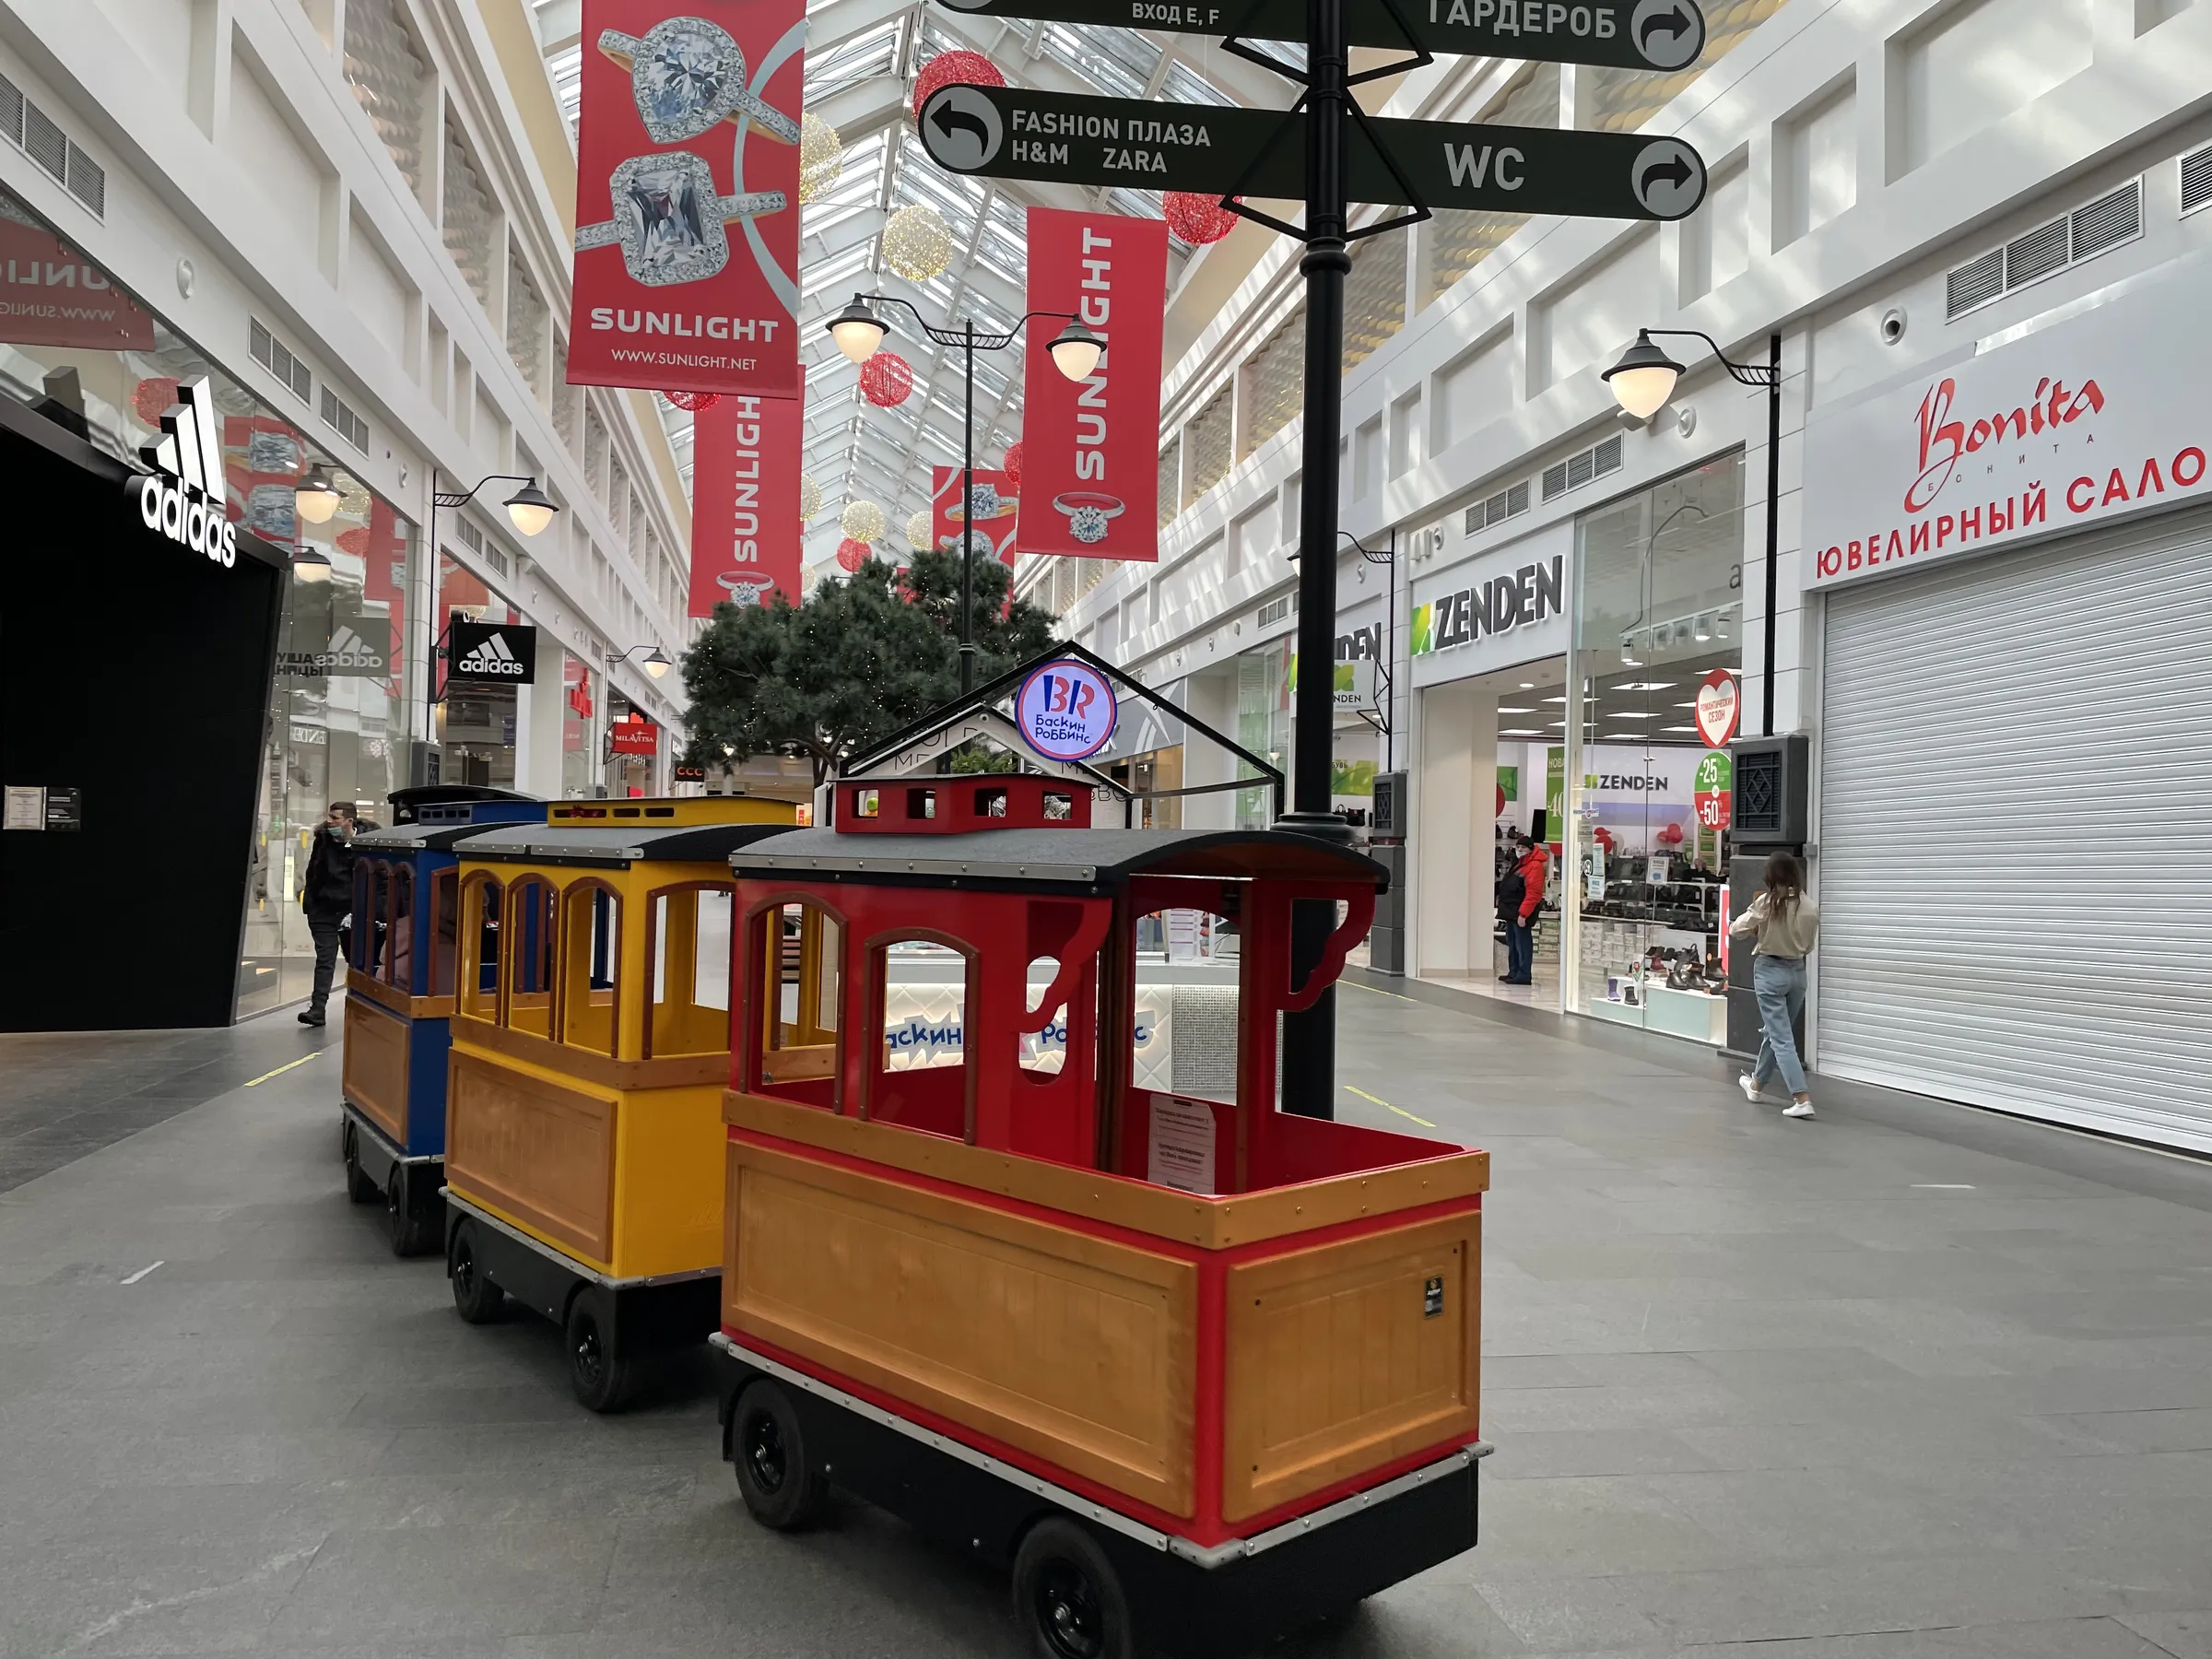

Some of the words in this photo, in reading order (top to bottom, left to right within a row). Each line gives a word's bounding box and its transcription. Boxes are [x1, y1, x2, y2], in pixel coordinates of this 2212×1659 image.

[1132, 3, 1182, 25] ВХОД
[1209, 9, 1220, 25] F
[1012, 109, 1119, 139] FASHION
[1128, 120, 1211, 147] ПЛАЗА
[1012, 139, 1068, 164] H&M
[1102, 147, 1168, 173] ZARA
[1443, 143, 1525, 191] WC
[590, 308, 779, 342] SUNLIGHT
[611, 348, 758, 371] WWW.SUNLIGHT.NET
[1904, 377, 2105, 513] Bonita
[141, 476, 236, 569] adidas
[1817, 480, 2046, 579] ЮВЕЛИРНЫЙ
[2066, 447, 2206, 513] САЛО
[1435, 555, 1562, 650] ZENDEN
[459, 657, 524, 675] adidas
[1036, 714, 1086, 733] Баскин
[1708, 709, 1725, 724] СЕЗОН
[616, 734, 654, 744] MILAVITSA
[677, 767, 702, 776] CCC
[1599, 775, 1668, 791] ZENDEN
